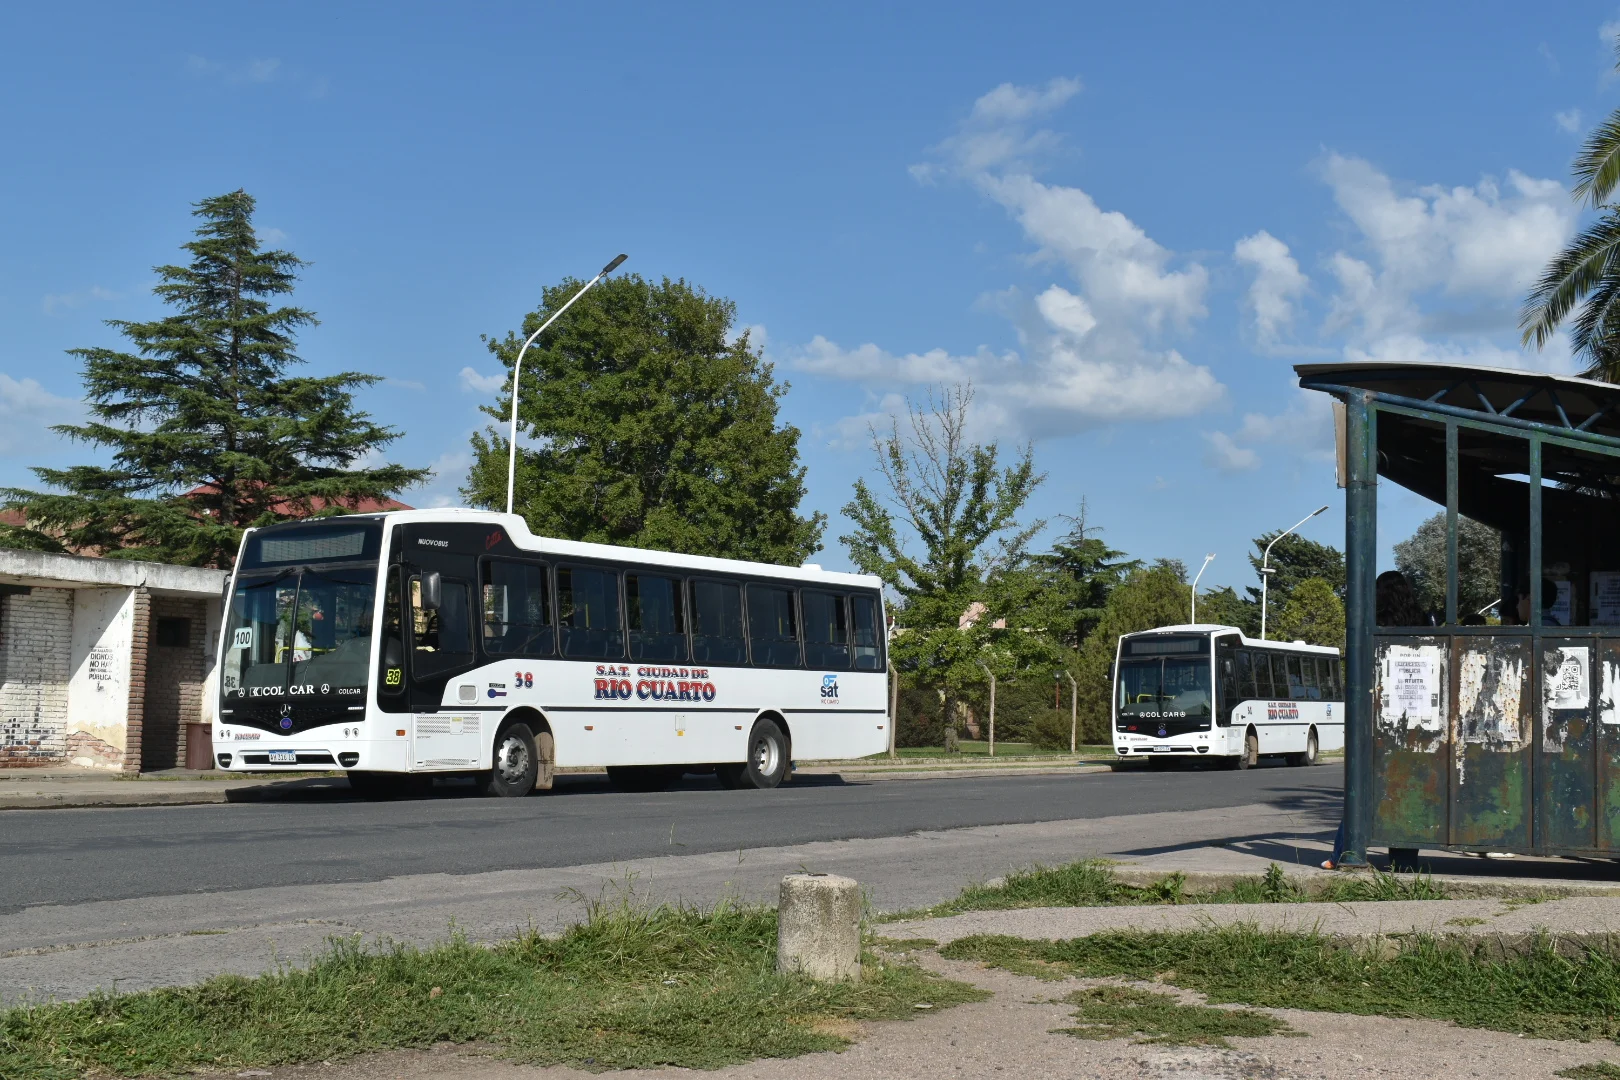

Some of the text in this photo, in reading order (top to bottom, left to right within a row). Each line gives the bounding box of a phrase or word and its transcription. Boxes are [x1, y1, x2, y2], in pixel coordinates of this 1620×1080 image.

[417, 538, 449, 547] NUOVOBUS
[236, 631, 251, 644] 100
[386, 669, 401, 685] 38
[596, 665, 709, 679] S.A.T. CIUDAD DE
[515, 671, 533, 689] 38
[263, 684, 315, 696] COL CAR
[594, 678, 716, 702] RIO CUARTO
[820, 681, 839, 697] sat
[1268, 709, 1298, 720] RIO CUARTO
